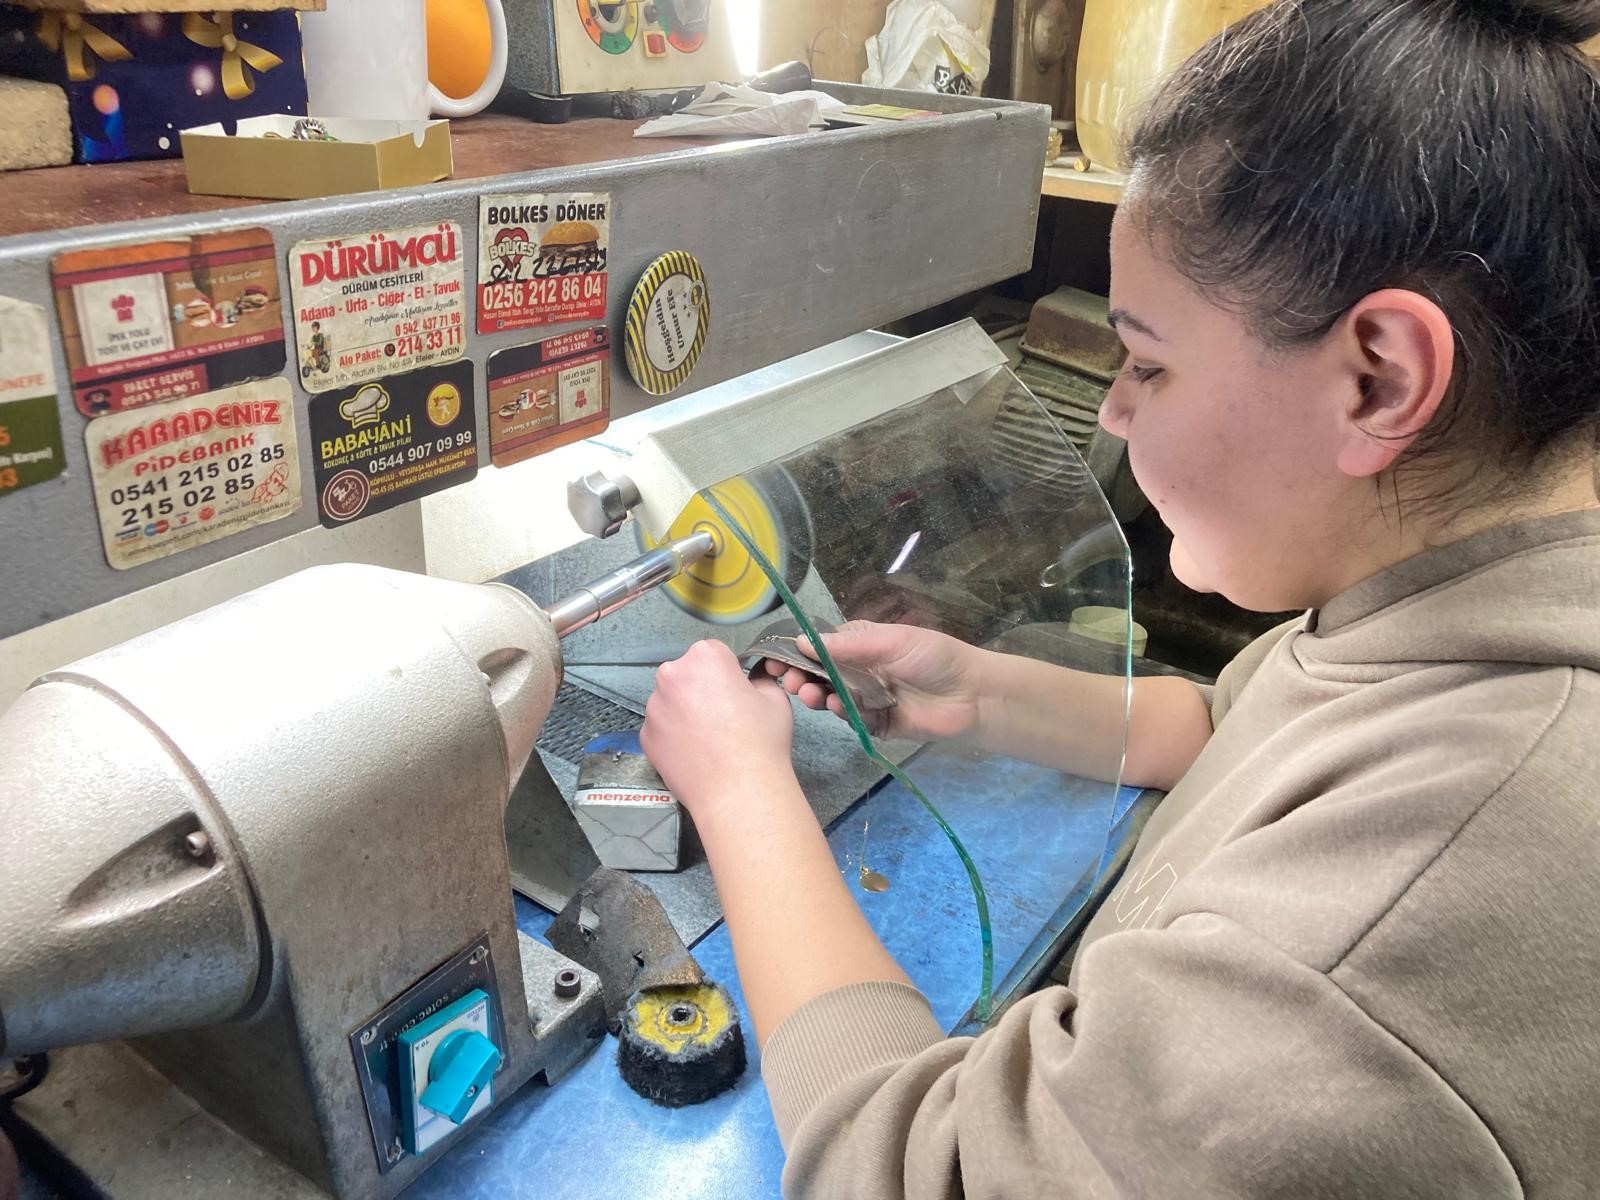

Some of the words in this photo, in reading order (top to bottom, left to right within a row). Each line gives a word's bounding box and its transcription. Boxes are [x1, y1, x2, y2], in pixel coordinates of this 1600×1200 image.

[488, 206, 548, 224] BOLKES
[556, 200, 606, 221] DÖNER
[300, 223, 456, 287] DÜRÜMCÜ
[489, 240, 536, 260] BOLKES
[301, 304, 336, 322] Adana
[346, 297, 368, 314] Urfa
[378, 290, 404, 308] Ciğer
[414, 286, 424, 299] Et
[433, 279, 460, 298] Tavuk
[342, 279, 378, 296] DÜRÜM
[484, 283, 524, 310] 0256
[528, 279, 556, 305] 212
[562, 278, 580, 302] 86
[584, 275, 601, 298] 04
[667, 289, 676, 310] Efe
[395, 325, 400, 337] 0
[403, 320, 418, 335] 542
[422, 316, 437, 331] 437
[440, 314, 448, 328] 71
[450, 312, 461, 326] 96
[672, 312, 684, 350] Umur
[339, 355, 353, 368] Alo
[356, 349, 382, 364] Paket:
[398, 336, 423, 358] 214
[426, 331, 443, 350] 33
[446, 327, 461, 346] 11
[416, 352, 434, 364] Efeler
[440, 346, 460, 358] AYDIN
[159, 368, 195, 384] SERVİS
[172, 384, 188, 395] 90
[100, 400, 281, 470] KARADENİZ
[134, 432, 256, 477] PİDEBANK
[350, 453, 354, 462] &
[374, 446, 378, 456] &
[379, 440, 396, 454] TAVUK
[369, 452, 404, 474] 0544
[408, 443, 432, 462] 907
[436, 436, 452, 452] 09
[456, 430, 472, 446] 99
[110, 476, 168, 506] 0541
[179, 462, 220, 486] 215
[227, 453, 254, 472] 02
[260, 443, 285, 464] 85
[122, 497, 174, 526] 215
[184, 486, 216, 508] 02
[224, 473, 255, 494] 85
[587, 792, 670, 802] menzerna
